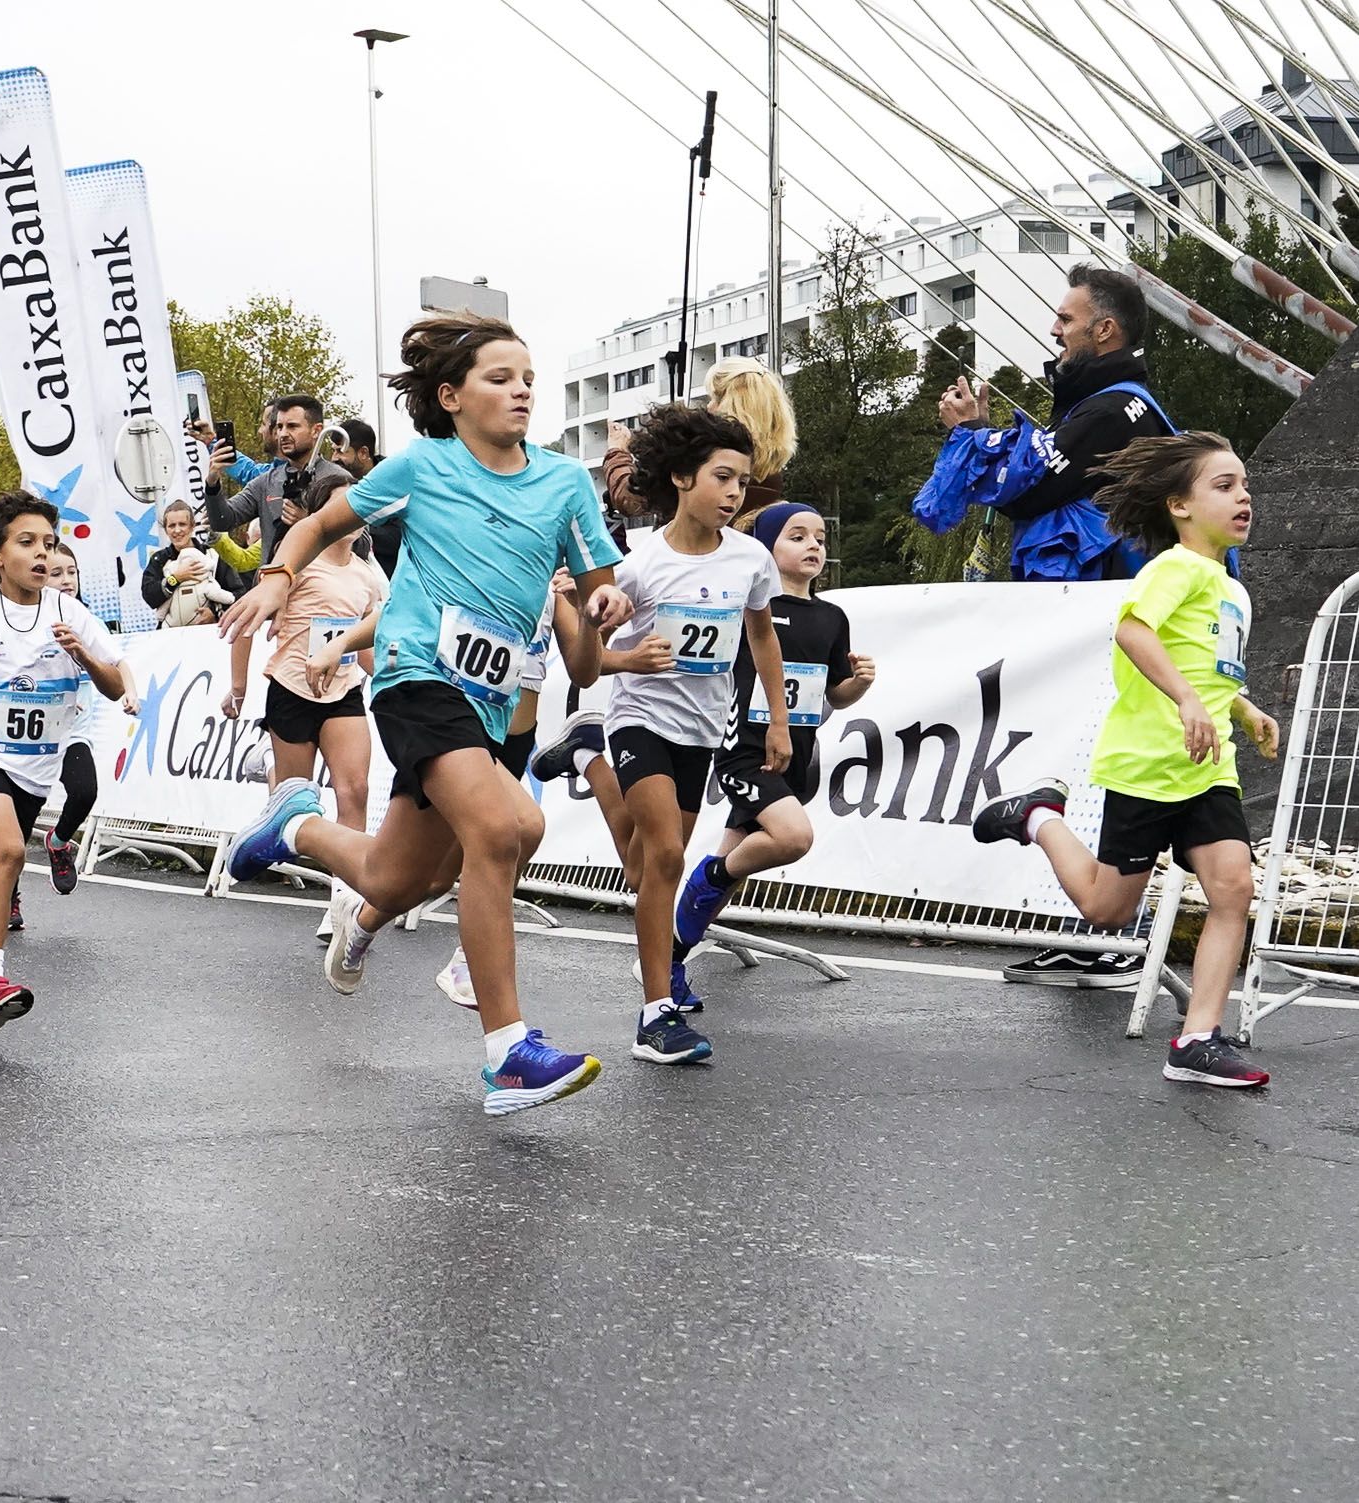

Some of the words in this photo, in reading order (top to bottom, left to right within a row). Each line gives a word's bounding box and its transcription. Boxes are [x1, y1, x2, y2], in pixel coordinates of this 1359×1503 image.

[90, 226, 153, 418] ixaBank
[1123, 396, 1149, 424] HH
[455, 632, 511, 686] 109
[678, 623, 719, 659] 22
[6, 708, 46, 740] 56
[167, 670, 274, 784] Caixa
[802, 658, 1033, 826] ank
